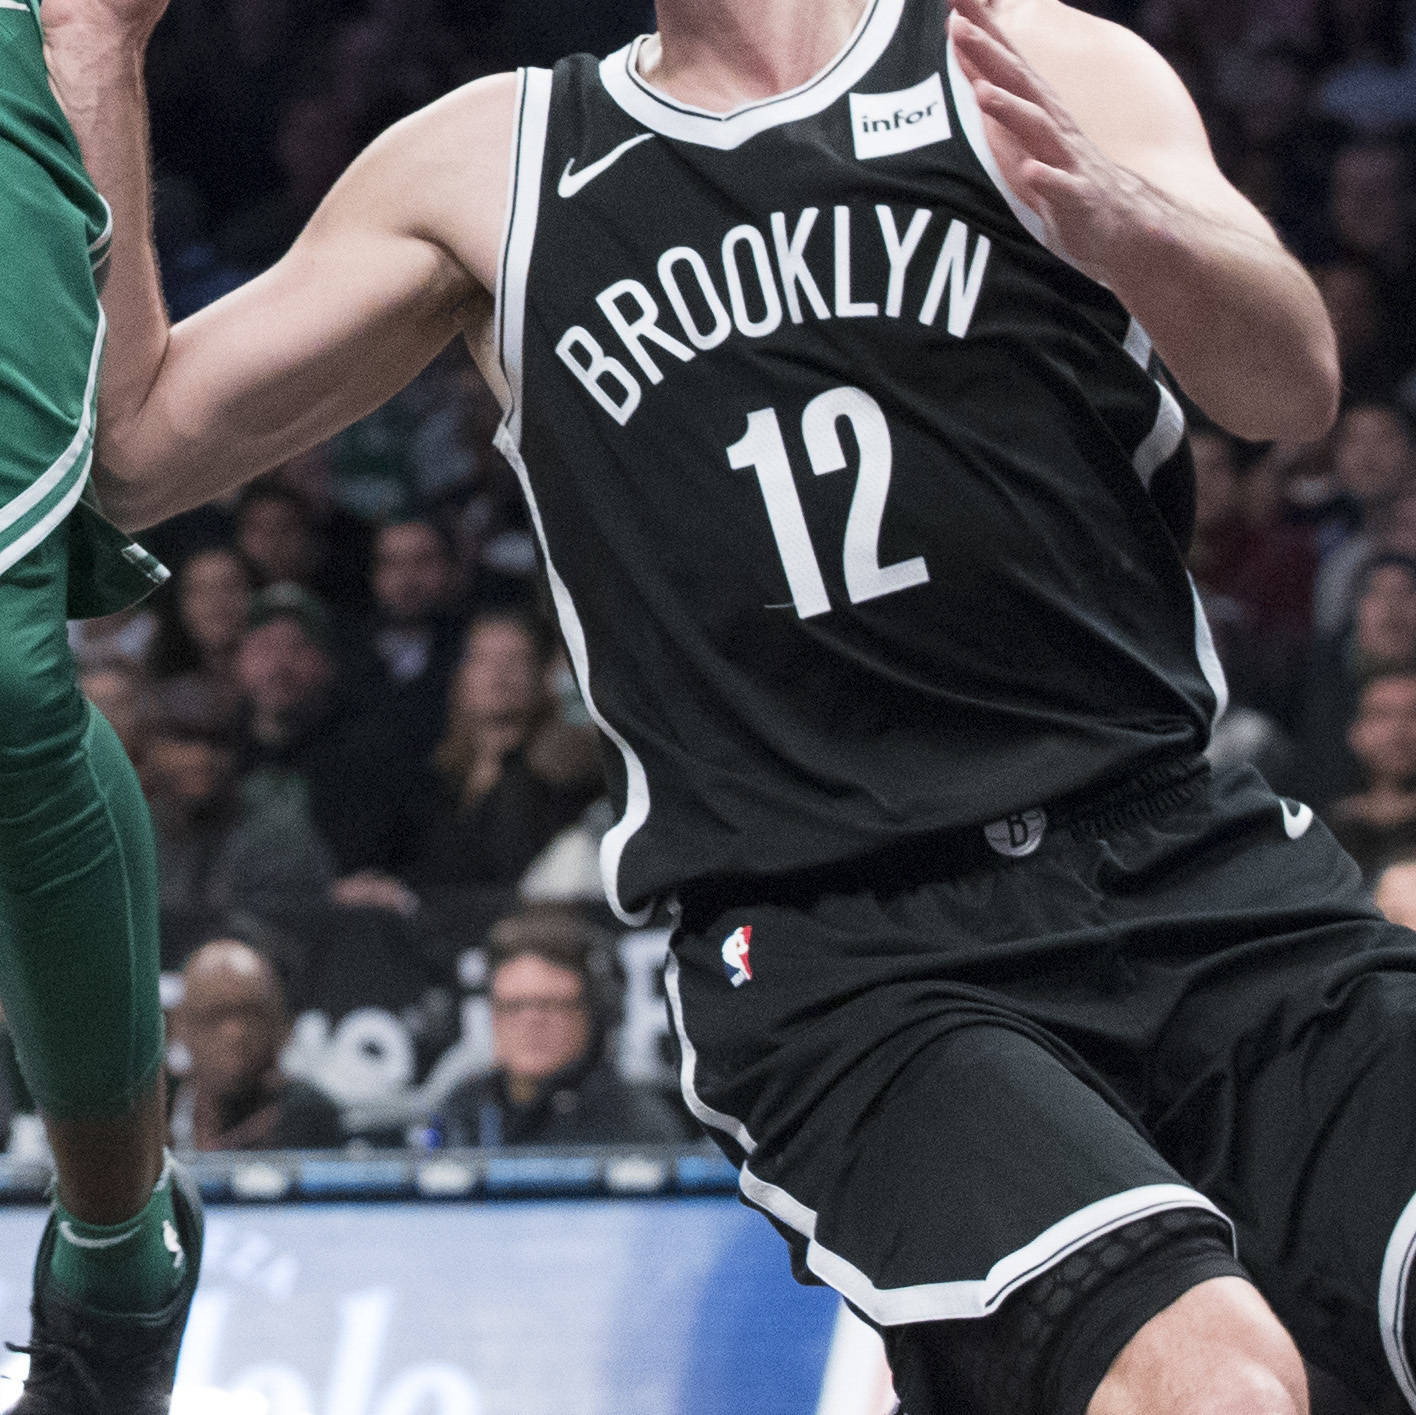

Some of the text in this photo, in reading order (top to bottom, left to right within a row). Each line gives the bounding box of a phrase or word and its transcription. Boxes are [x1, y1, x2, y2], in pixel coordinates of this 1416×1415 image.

[861, 100, 939, 135] infor
[554, 203, 992, 427] BROOKLYN
[725, 385, 931, 620] 12
